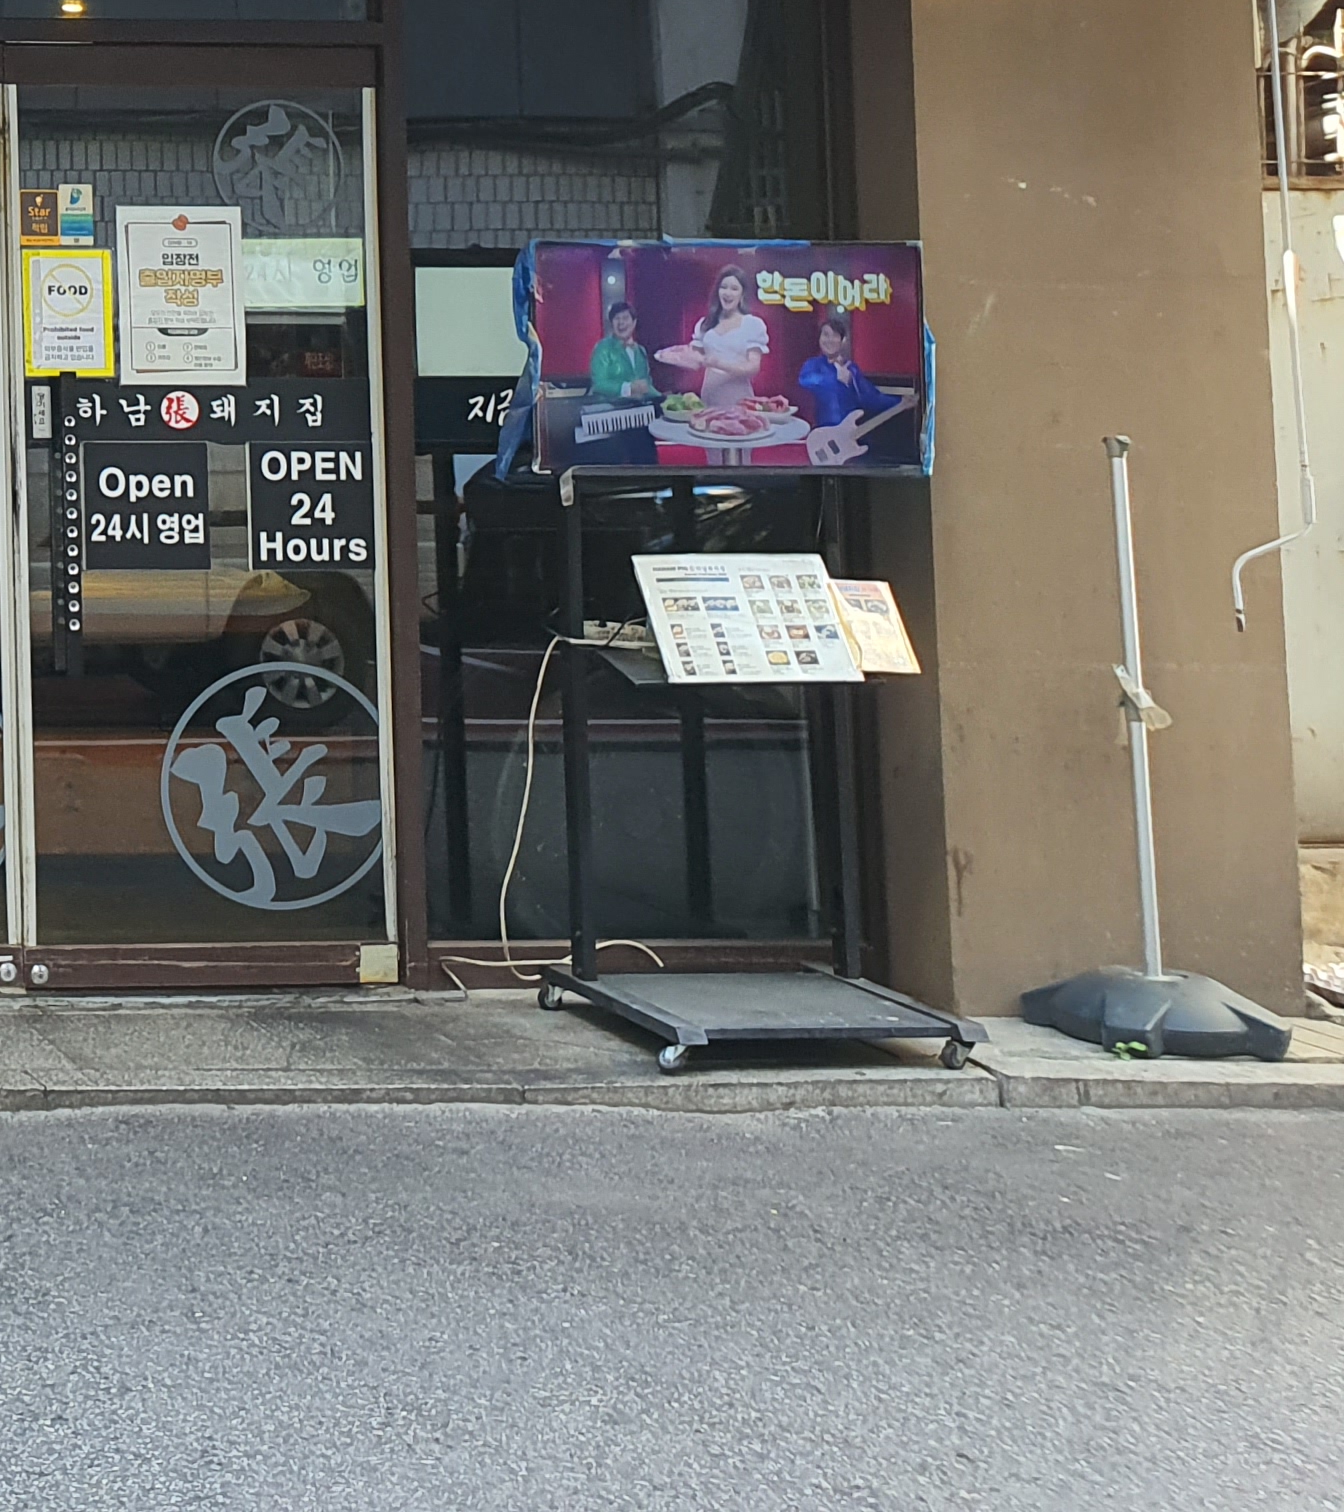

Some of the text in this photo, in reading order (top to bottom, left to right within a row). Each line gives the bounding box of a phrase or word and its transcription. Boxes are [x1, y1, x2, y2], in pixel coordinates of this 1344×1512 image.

[28, 206, 51, 217] Star
[161, 252, 200, 266] 입장전
[138, 267, 224, 288] 출입자명부
[47, 284, 89, 296] FOOD
[164, 288, 199, 307] 작성
[42, 326, 94, 334] Prohibited food
[261, 450, 363, 482] OPEN
[98, 466, 194, 503] Open
[290, 492, 336, 526] 24
[90, 512, 205, 546] 24시 영업
[259, 531, 369, 563] Hours
